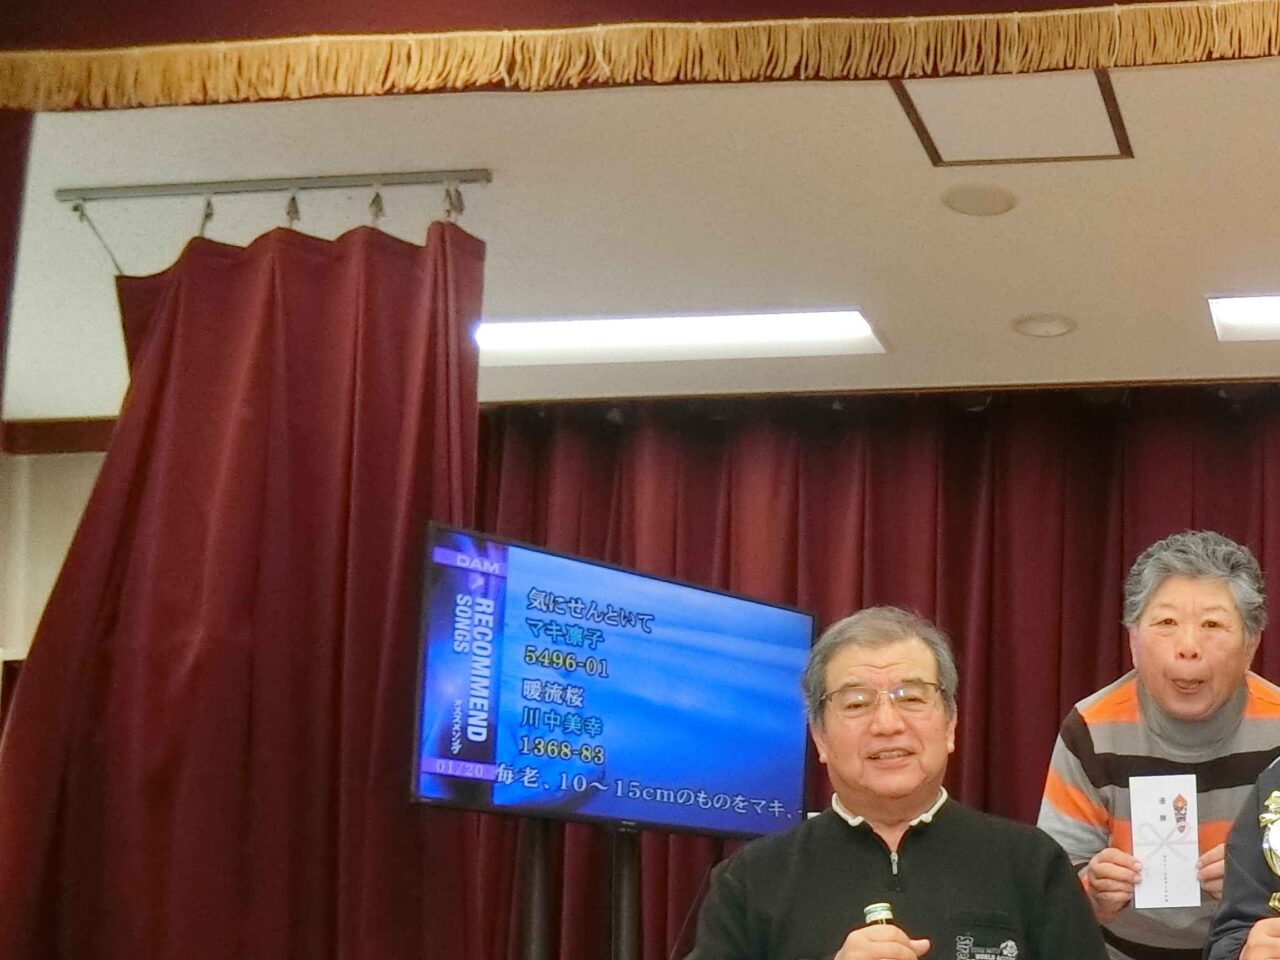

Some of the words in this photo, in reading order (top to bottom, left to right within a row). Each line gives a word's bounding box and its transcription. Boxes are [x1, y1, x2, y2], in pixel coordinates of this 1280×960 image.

[456, 554, 500, 575] DAM
[453, 593, 473, 654] SONGS
[526, 587, 655, 633] 気にせんといて
[467, 597, 495, 743] RECOMMEND
[524, 645, 609, 679] 5496-01
[522, 679, 585, 709] 暖流桜
[520, 706, 604, 738] 川中美幸
[519, 736, 604, 764] 1368-83
[436, 760, 484, 777] 01/20
